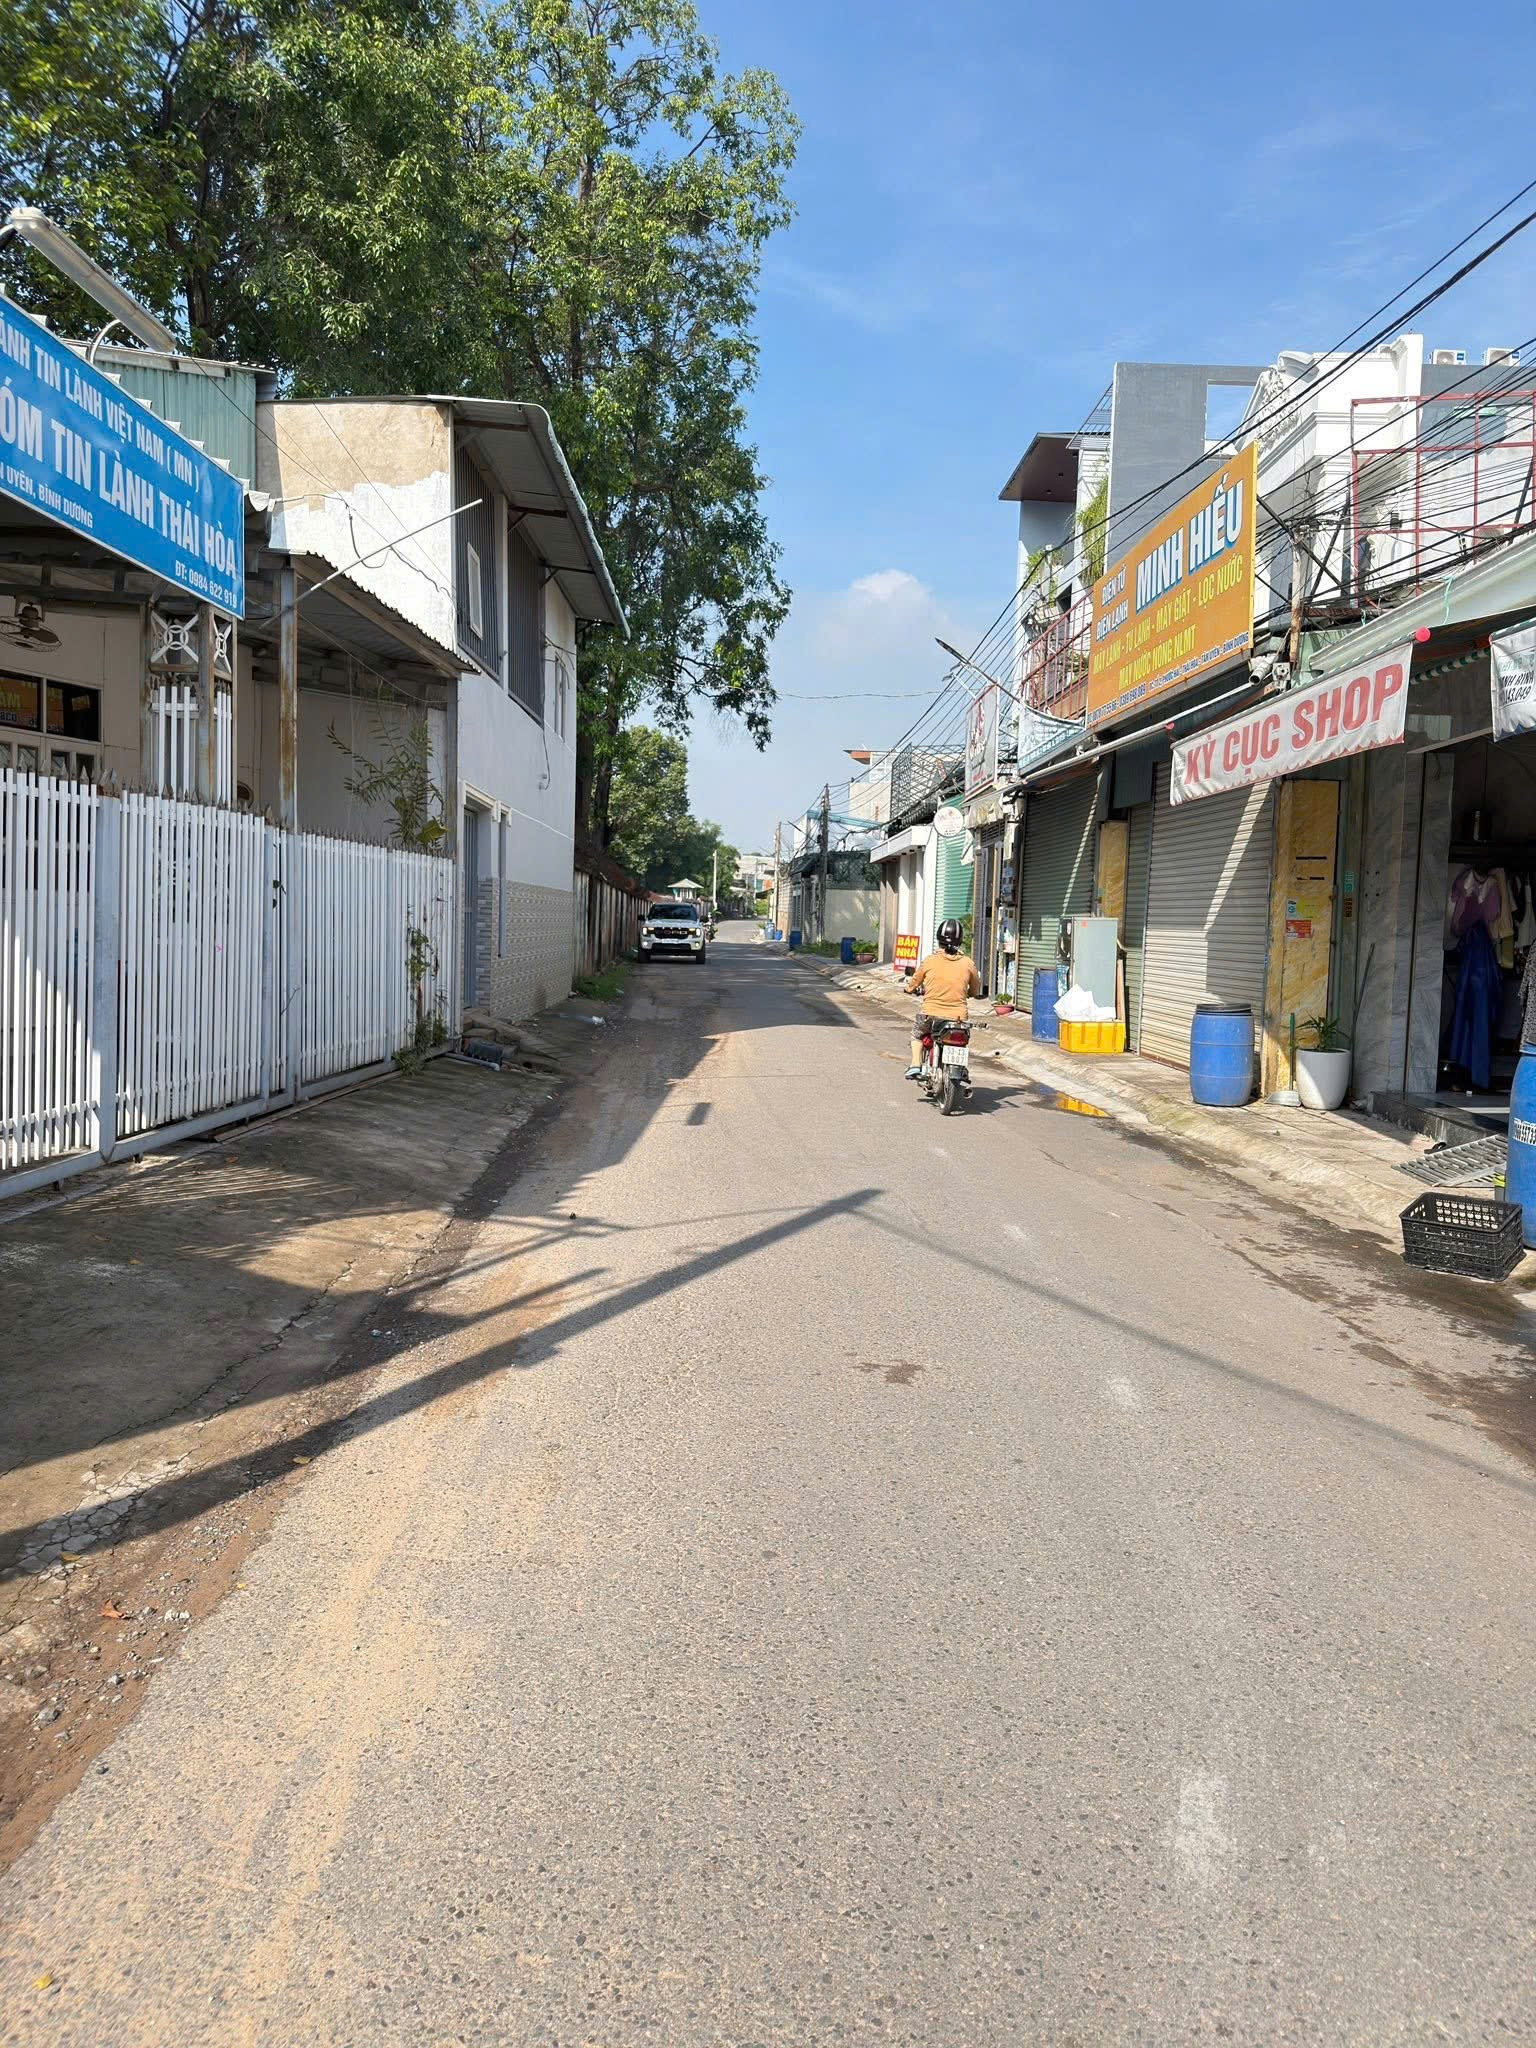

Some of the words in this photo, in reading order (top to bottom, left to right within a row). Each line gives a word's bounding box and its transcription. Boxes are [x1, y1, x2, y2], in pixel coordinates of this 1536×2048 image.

[35, 344, 60, 392] TIN
[65, 367, 103, 421] LÀNH
[105, 397, 133, 443] VIỆT
[136, 421, 163, 465] NAM
[174, 450, 192, 487] MN
[38, 483, 61, 511] BÌNH
[63, 498, 93, 528] DƯƠNG
[51, 418, 91, 491] TIN
[99, 449, 154, 530] LÀNH
[160, 491, 199, 557] THÁI
[205, 521, 236, 580] HÒA
[1136, 527, 1184, 613] MINH
[1189, 471, 1243, 573] HIẾU
[175, 560, 187, 580] ĐT:
[189, 569, 208, 592] 0984
[209, 581, 223, 600] 622
[224, 589, 237, 608] 919
[1135, 616, 1150, 651] LẠNH
[1156, 600, 1172, 634] MÁY
[1198, 573, 1214, 609] LỌC
[1216, 553, 1242, 596] NƯỚC
[1223, 714, 1281, 776] CỤC
[1292, 663, 1403, 749] SHOP
[897, 936, 918, 948] BÁN
